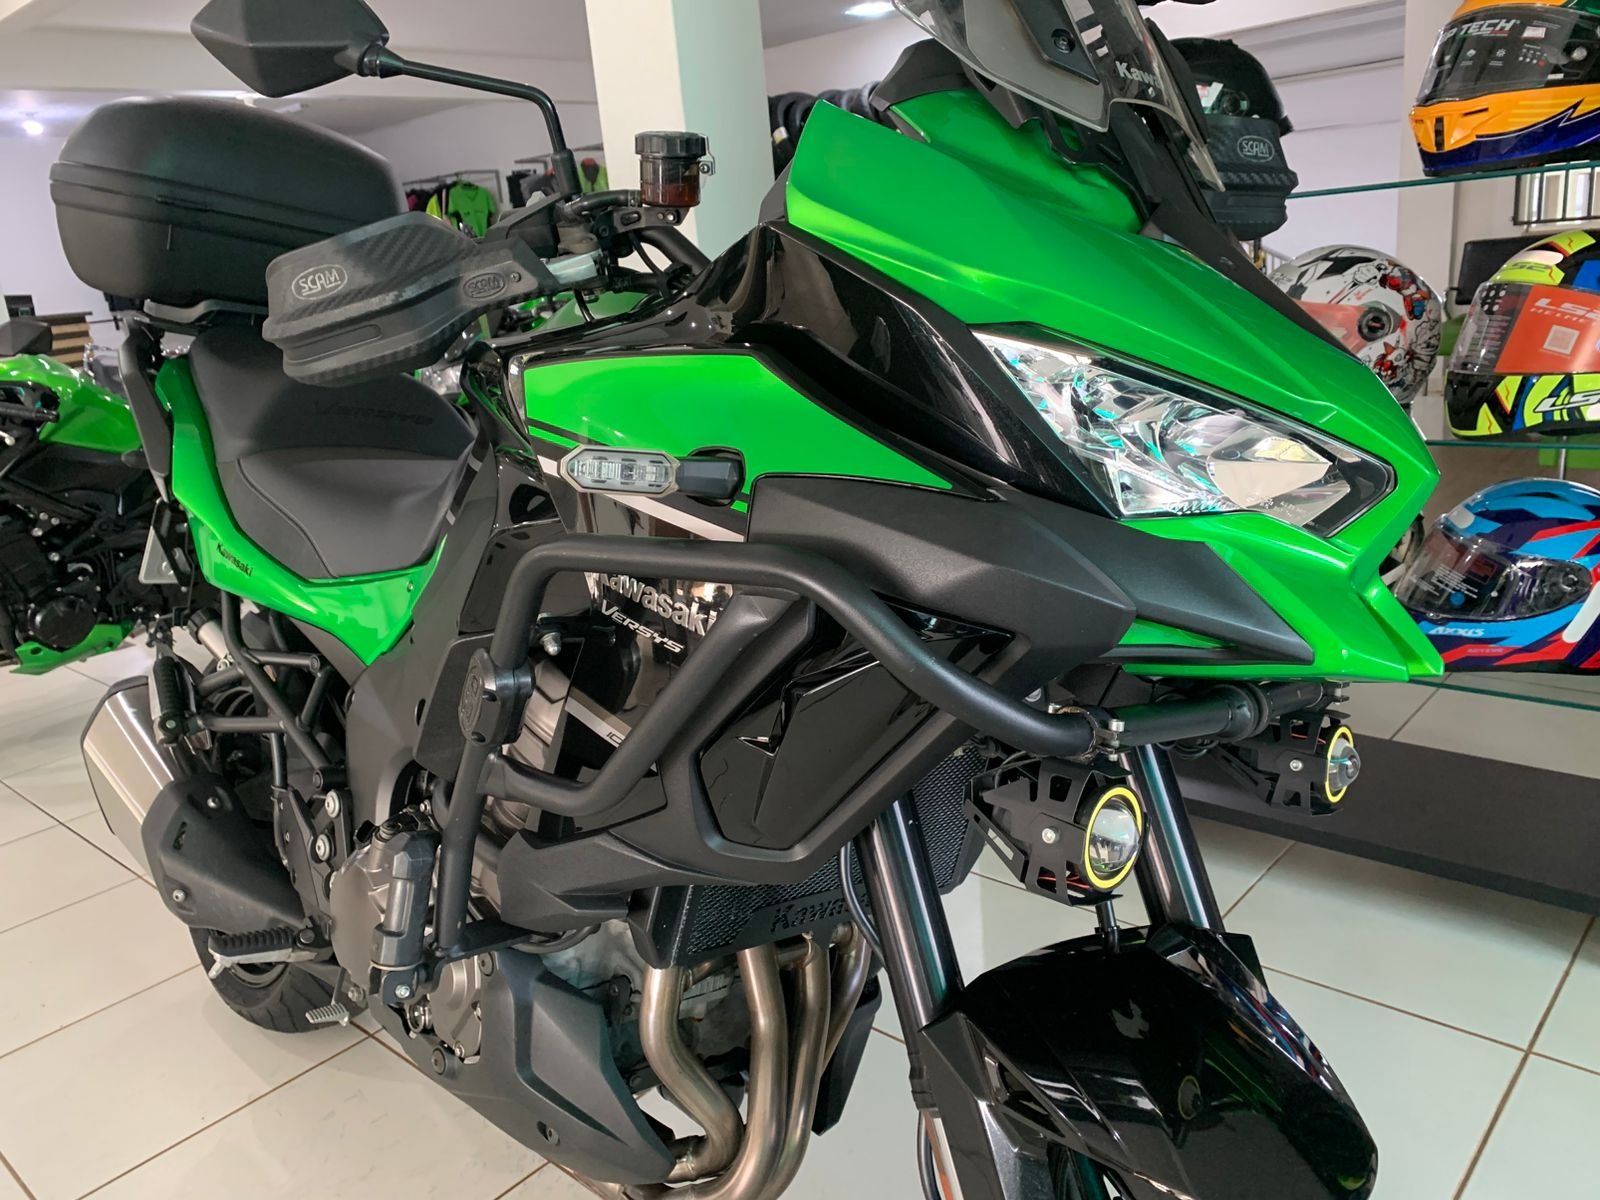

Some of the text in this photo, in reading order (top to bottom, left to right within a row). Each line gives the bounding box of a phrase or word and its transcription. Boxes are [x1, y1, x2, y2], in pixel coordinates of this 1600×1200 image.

[1242, 140, 1270, 157] SCAM
[299, 267, 341, 295] SCAM
[216, 543, 253, 577] Kawasaki
[601, 599, 684, 653] VERSYS
[1428, 626, 1485, 637] AXXIS
